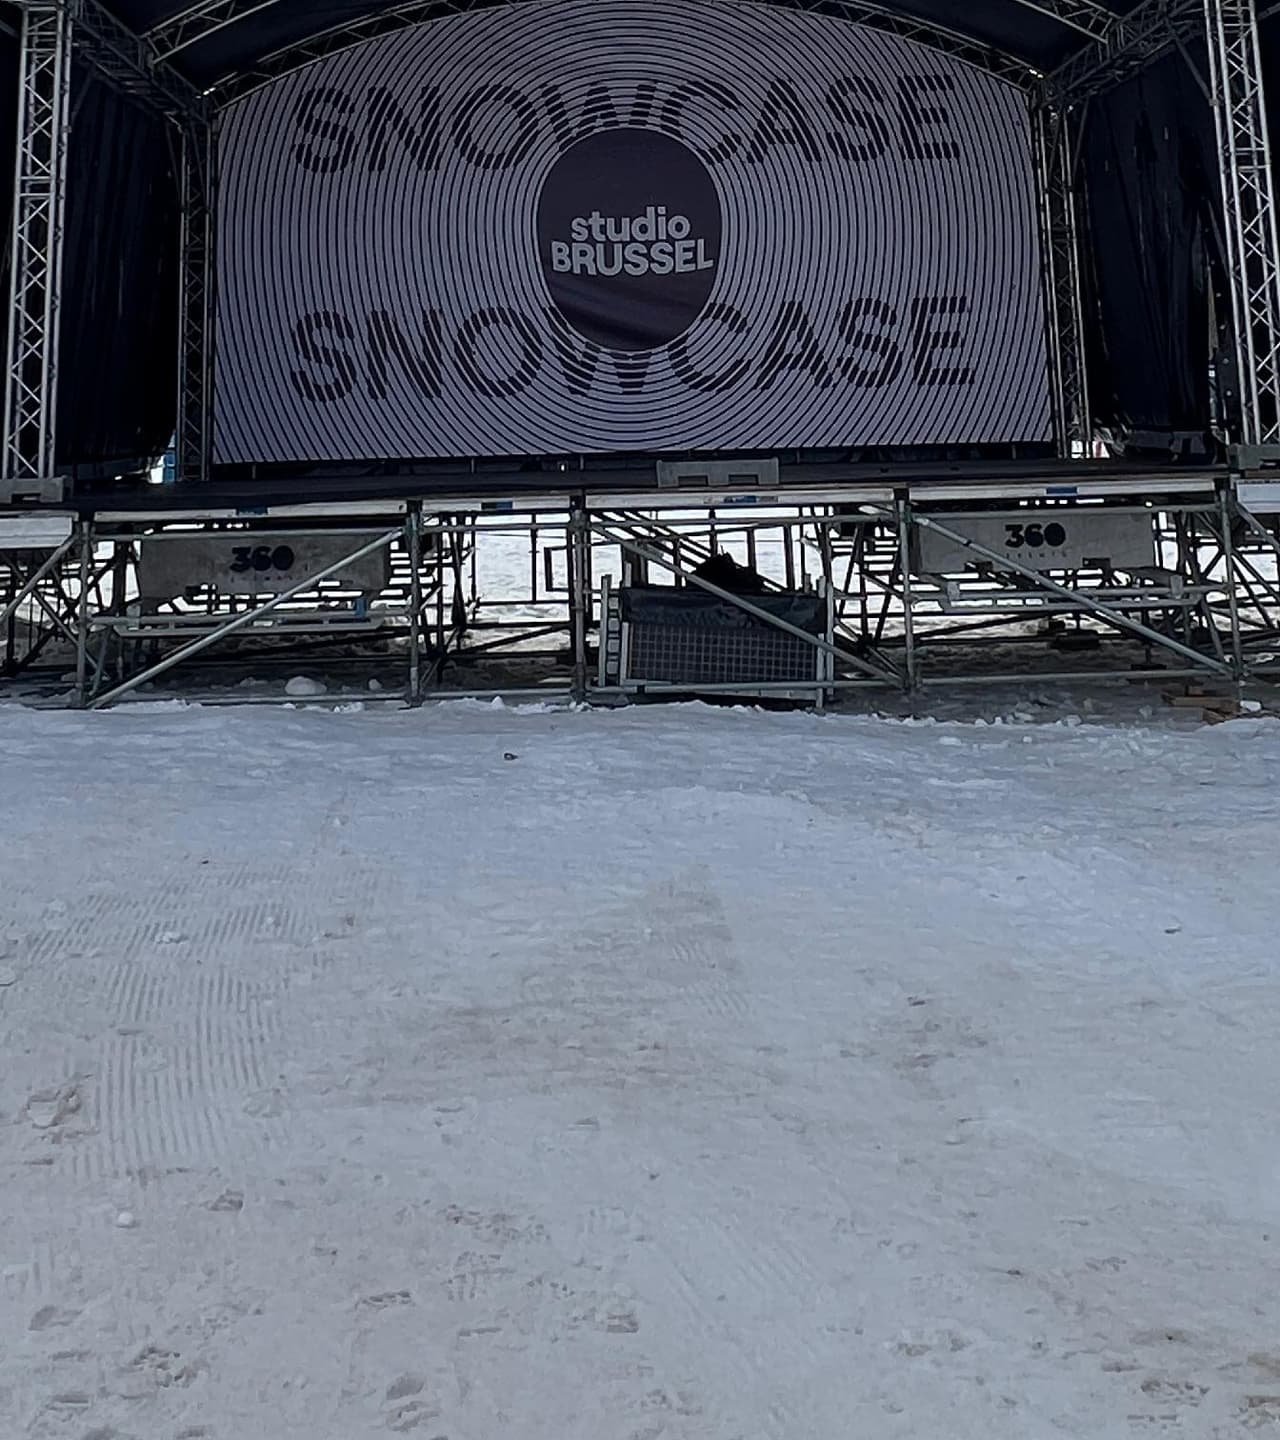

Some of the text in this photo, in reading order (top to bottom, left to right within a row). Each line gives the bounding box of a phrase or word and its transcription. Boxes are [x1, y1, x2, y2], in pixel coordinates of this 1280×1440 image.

[570, 205, 692, 243] studio
[551, 238, 715, 277] BRUSSEL
[1004, 522, 1066, 548] 360
[229, 544, 294, 572] 360
